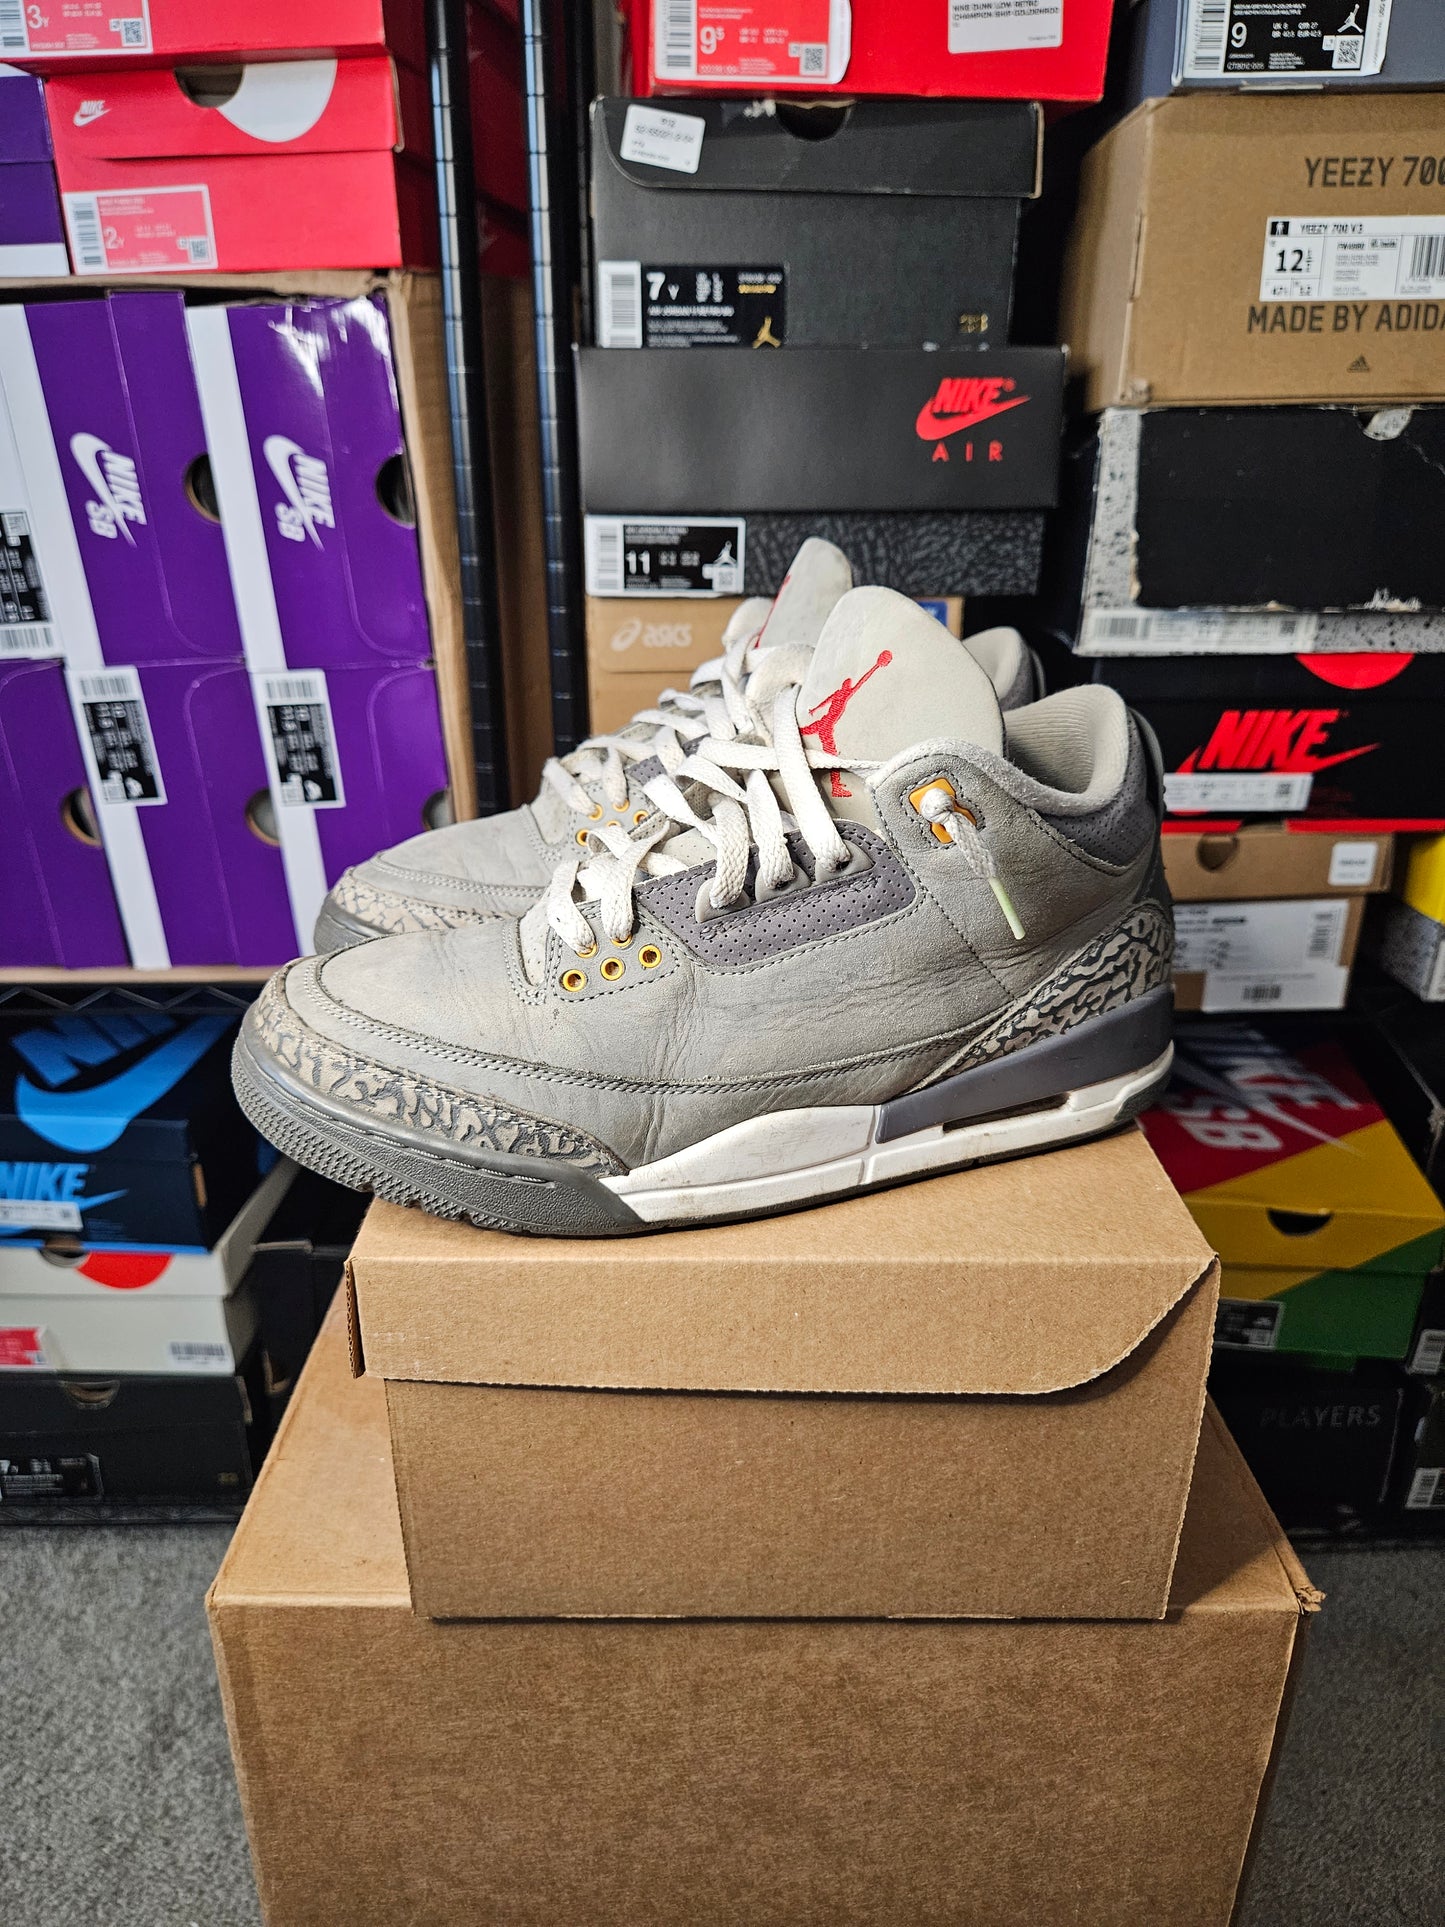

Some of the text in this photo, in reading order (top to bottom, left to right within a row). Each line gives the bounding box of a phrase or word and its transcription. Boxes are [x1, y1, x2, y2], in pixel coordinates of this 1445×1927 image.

[1230, 22, 1247, 48] 9
[80, 100, 105, 115] NIKE
[1305, 156, 1395, 188] YEEZY
[1248, 304, 1325, 334] MADE
[1333, 304, 1368, 333] BY
[932, 377, 1004, 414] NIKE
[931, 441, 1003, 462] AIR
[101, 451, 147, 525] NIKE
[292, 454, 335, 529] NIKE
[85, 500, 118, 539] SB
[274, 502, 306, 542] SB
[625, 550, 650, 574] 11
[1197, 709, 1340, 770] NIKE
[0, 1161, 90, 1201] NIKE
[1260, 1404, 1381, 1428] PLAYERS
